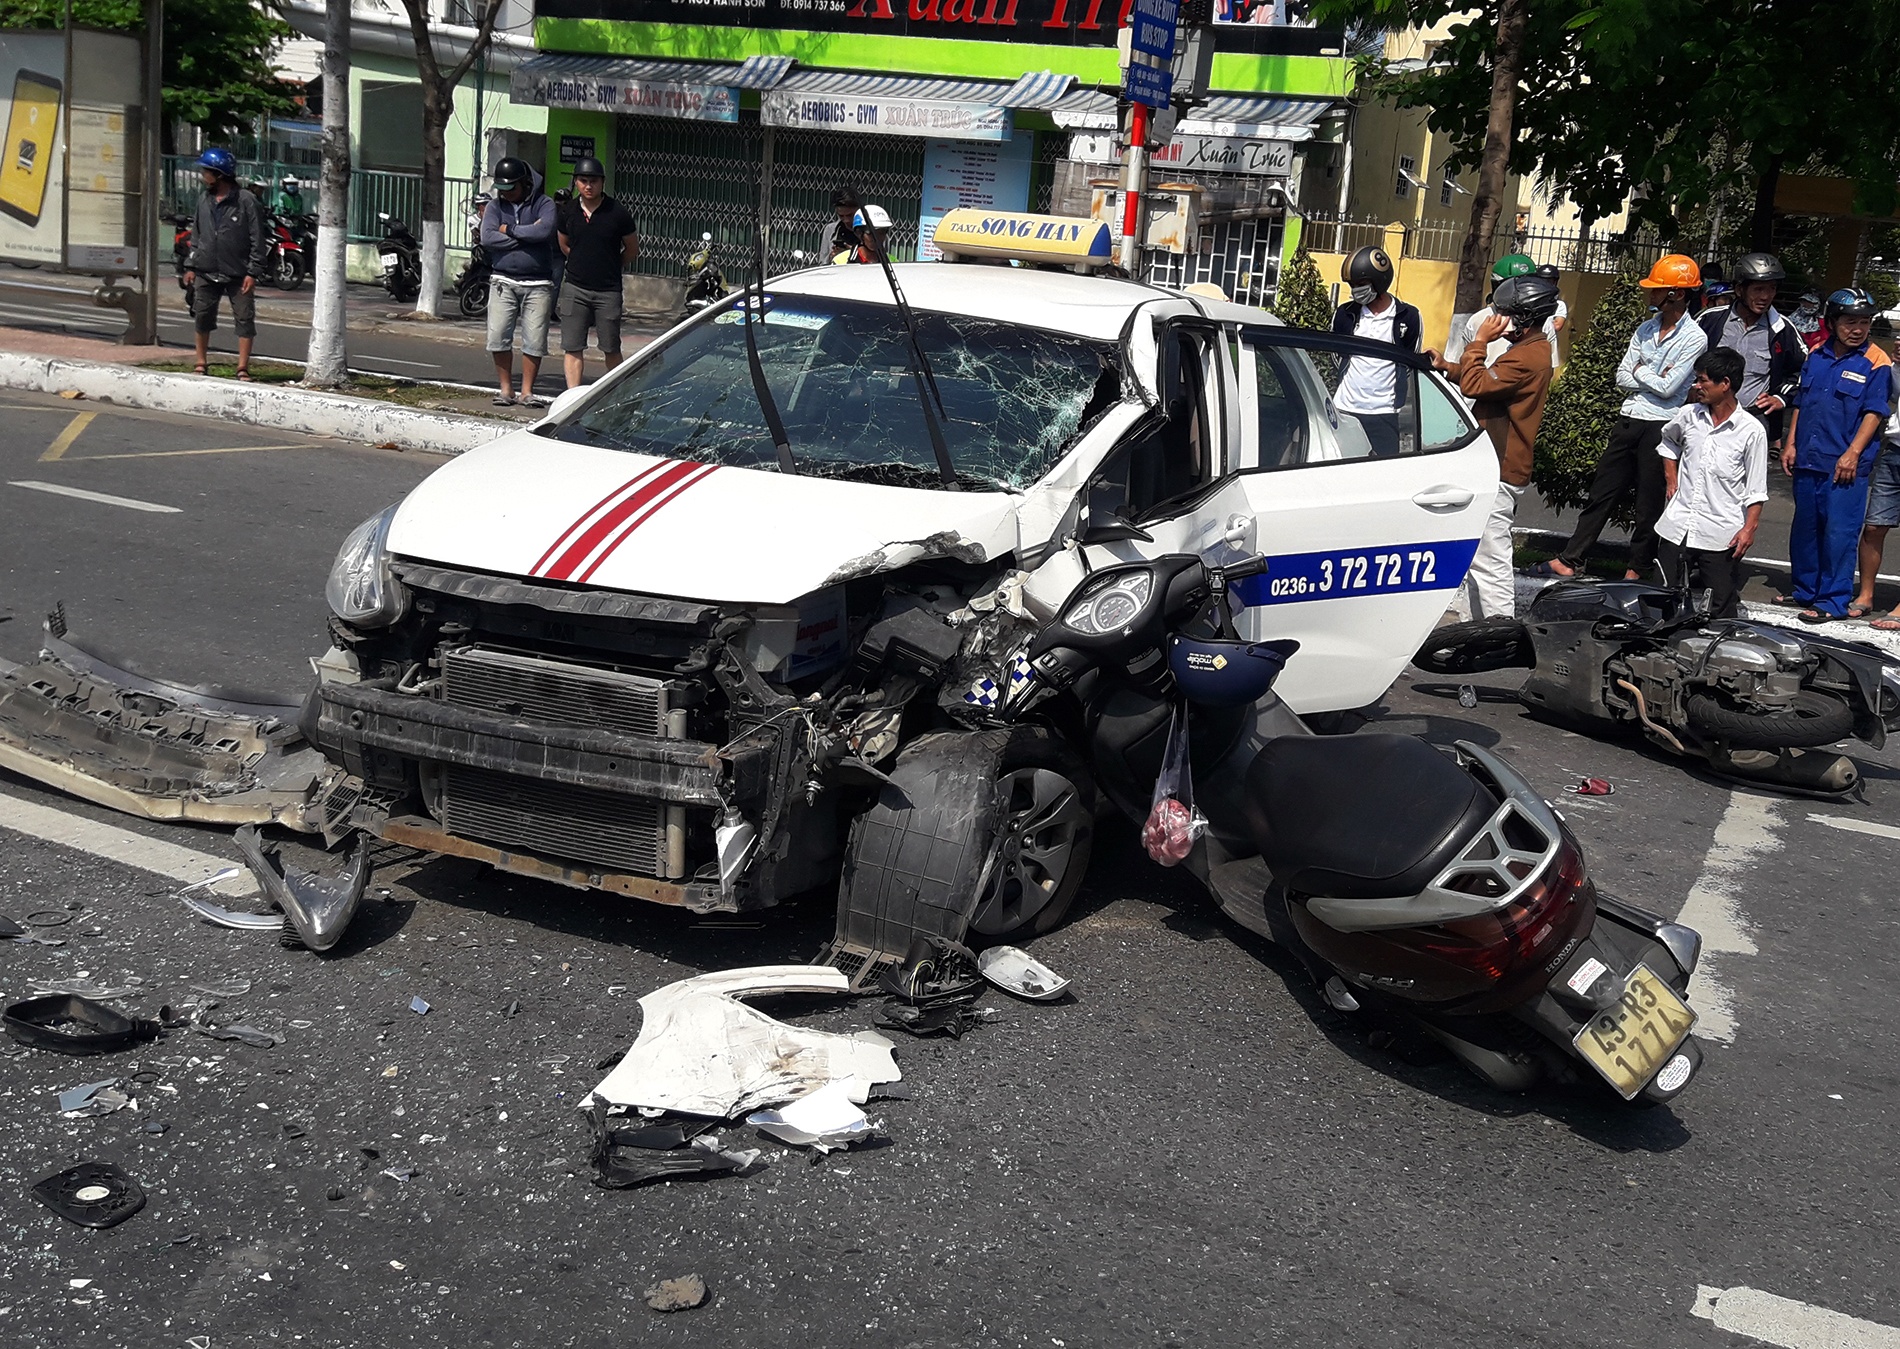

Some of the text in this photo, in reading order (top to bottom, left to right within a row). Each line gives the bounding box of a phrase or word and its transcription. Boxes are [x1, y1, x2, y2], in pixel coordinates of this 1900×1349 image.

[794, 0, 812, 10] 0914
[814, 0, 828, 10] 737
[830, 1, 846, 11] 366
[1141, 22, 1168, 50] BUS STOP
[547, 82, 587, 102] AEROBICS
[597, 84, 616, 104] GYM
[622, 85, 662, 107] XUÂN
[801, 101, 845, 122] AEROBICS
[856, 104, 878, 125] GYM
[884, 103, 929, 126] XUÂN
[932, 106, 972, 130] TRÚC
[1186, 139, 1238, 166] Xuân
[1241, 142, 1286, 169] Trúc
[950, 218, 1086, 242] TAXI SONG HAN
[1341, 556, 1368, 590] 72
[1375, 554, 1402, 586] 72
[1408, 550, 1436, 583] 72
[1544, 937, 1579, 974] HONDA
[1615, 1008, 1684, 1082] 1774
